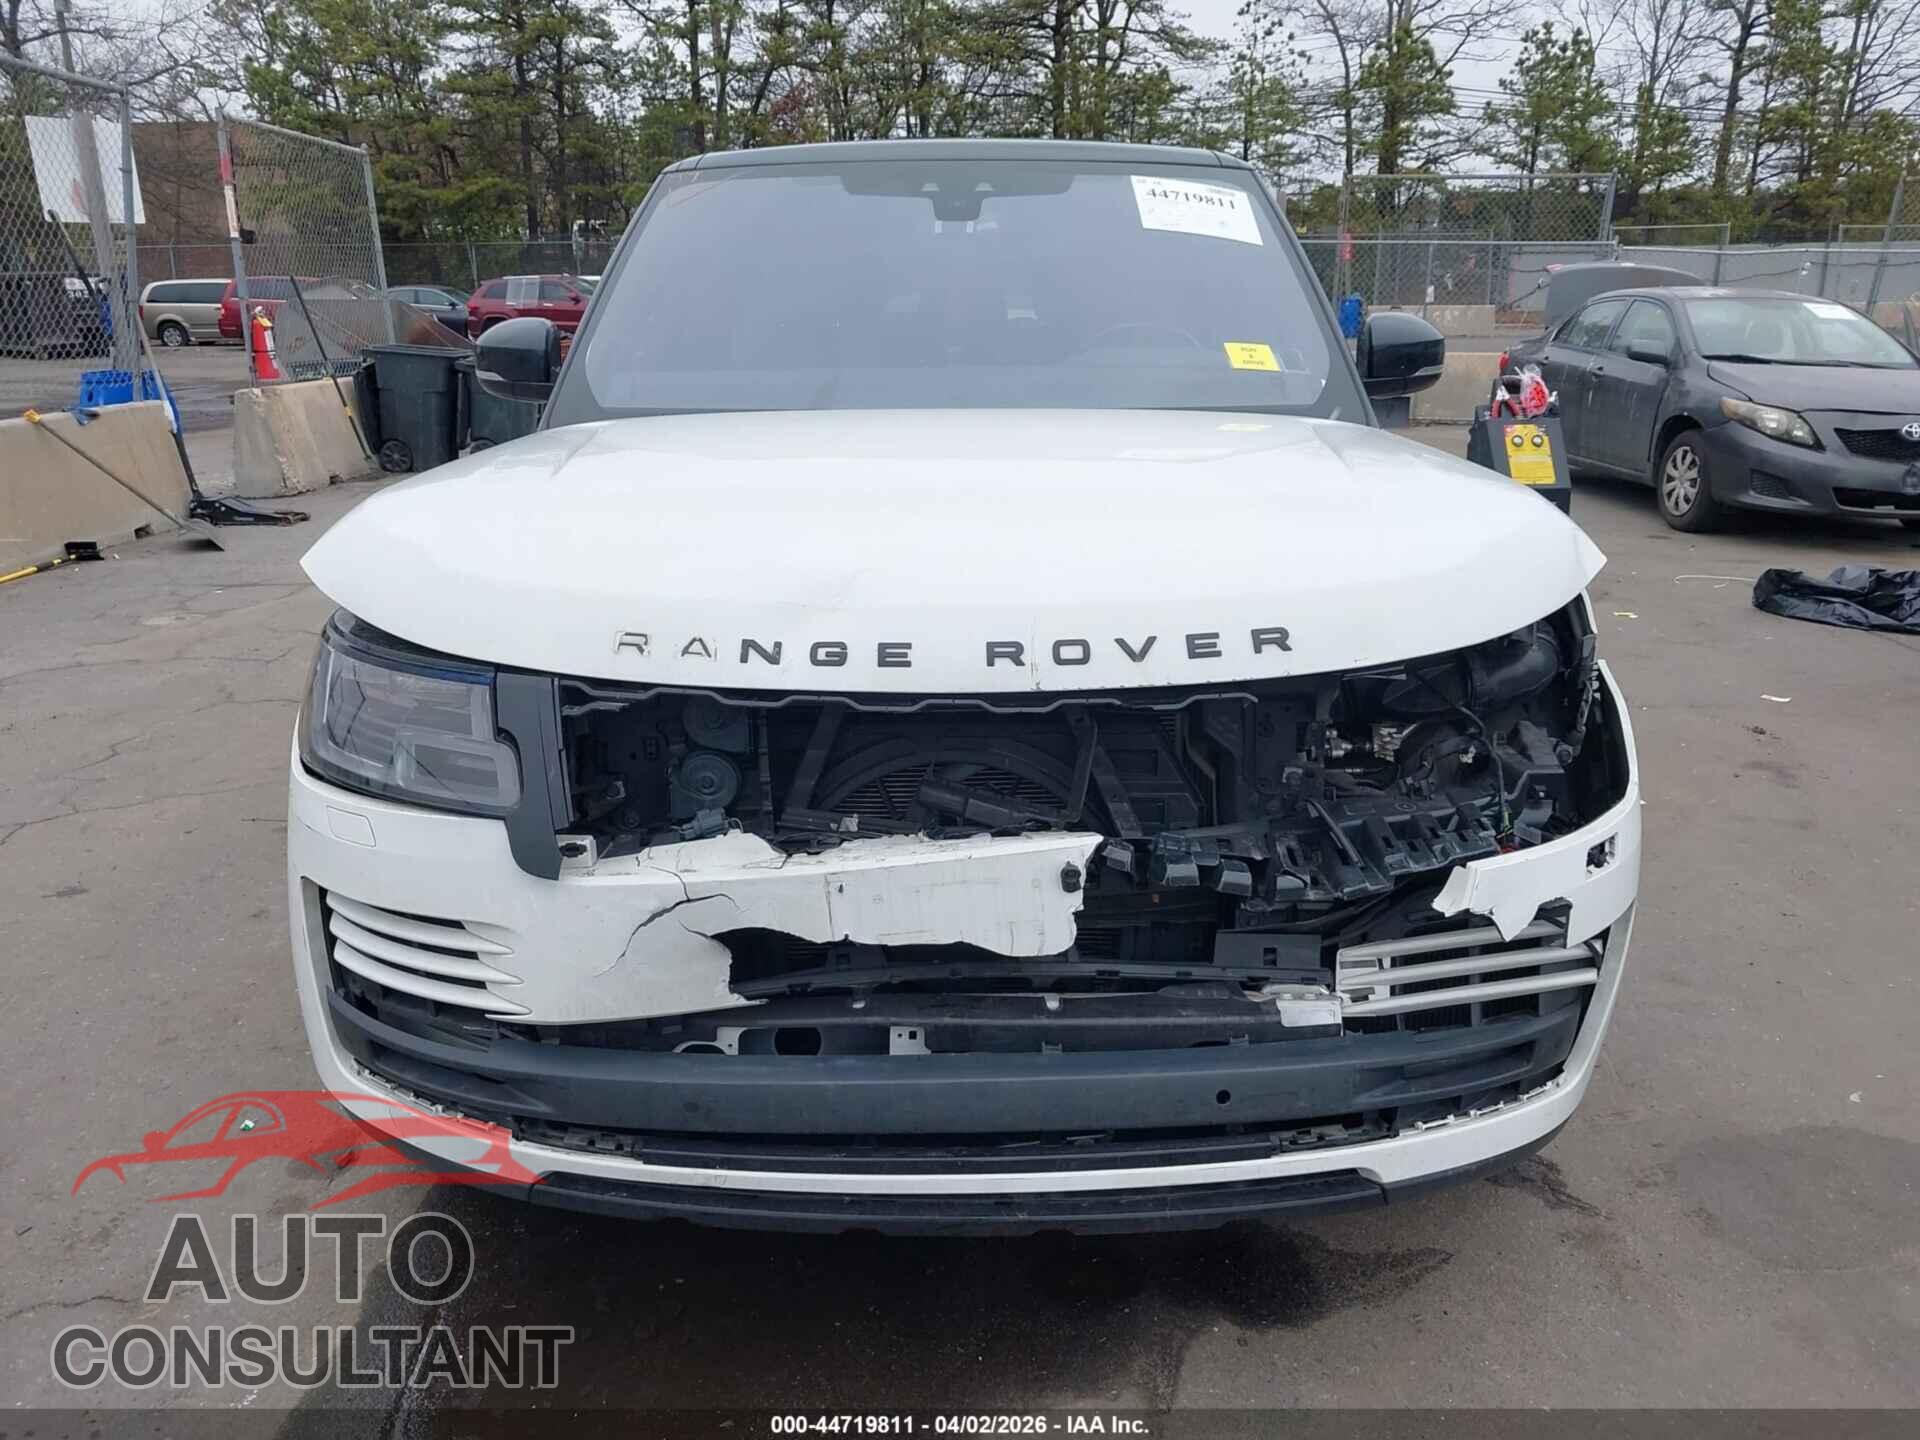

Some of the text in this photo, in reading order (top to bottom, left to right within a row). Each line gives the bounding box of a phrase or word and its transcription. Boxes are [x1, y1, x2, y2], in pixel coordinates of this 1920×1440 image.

[1146, 188, 1236, 210] 44719811
[613, 626, 1293, 668] RANGE ROVER
